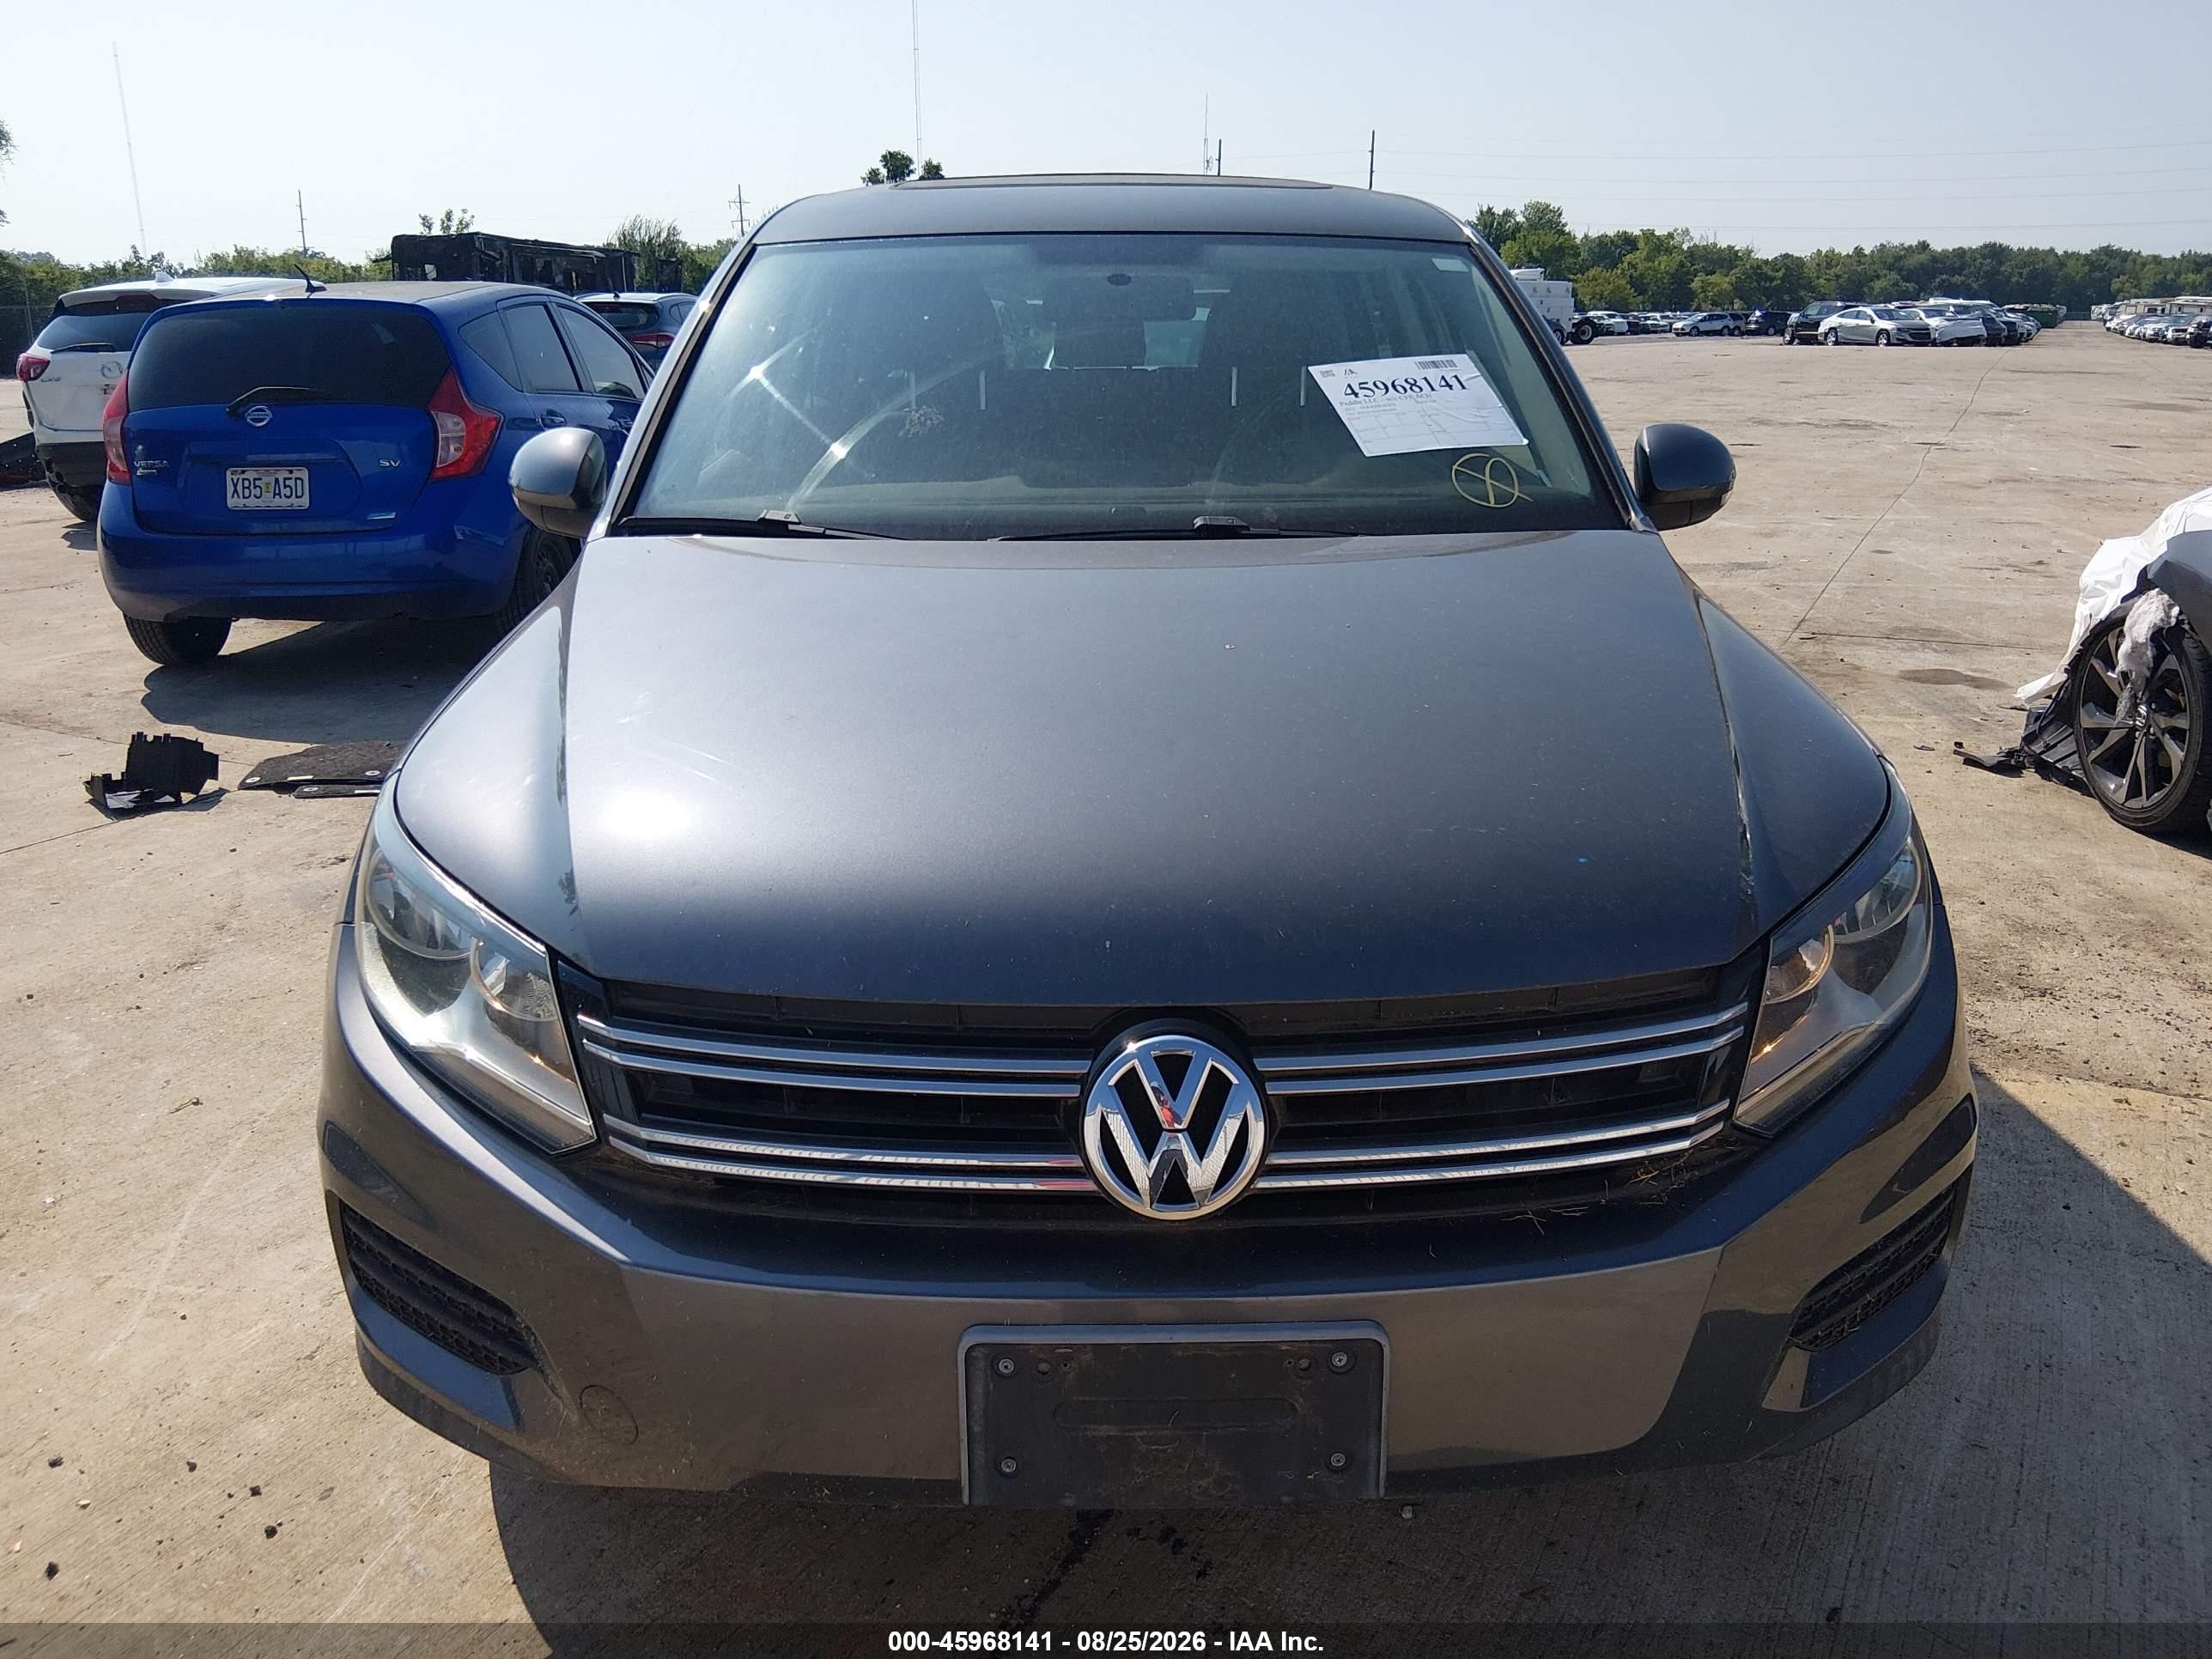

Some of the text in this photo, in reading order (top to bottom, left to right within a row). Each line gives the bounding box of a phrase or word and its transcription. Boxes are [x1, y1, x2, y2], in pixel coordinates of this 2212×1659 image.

[1344, 374, 1469, 398] 45968141
[230, 477, 263, 500] XB5
[273, 477, 305, 500] A5D
